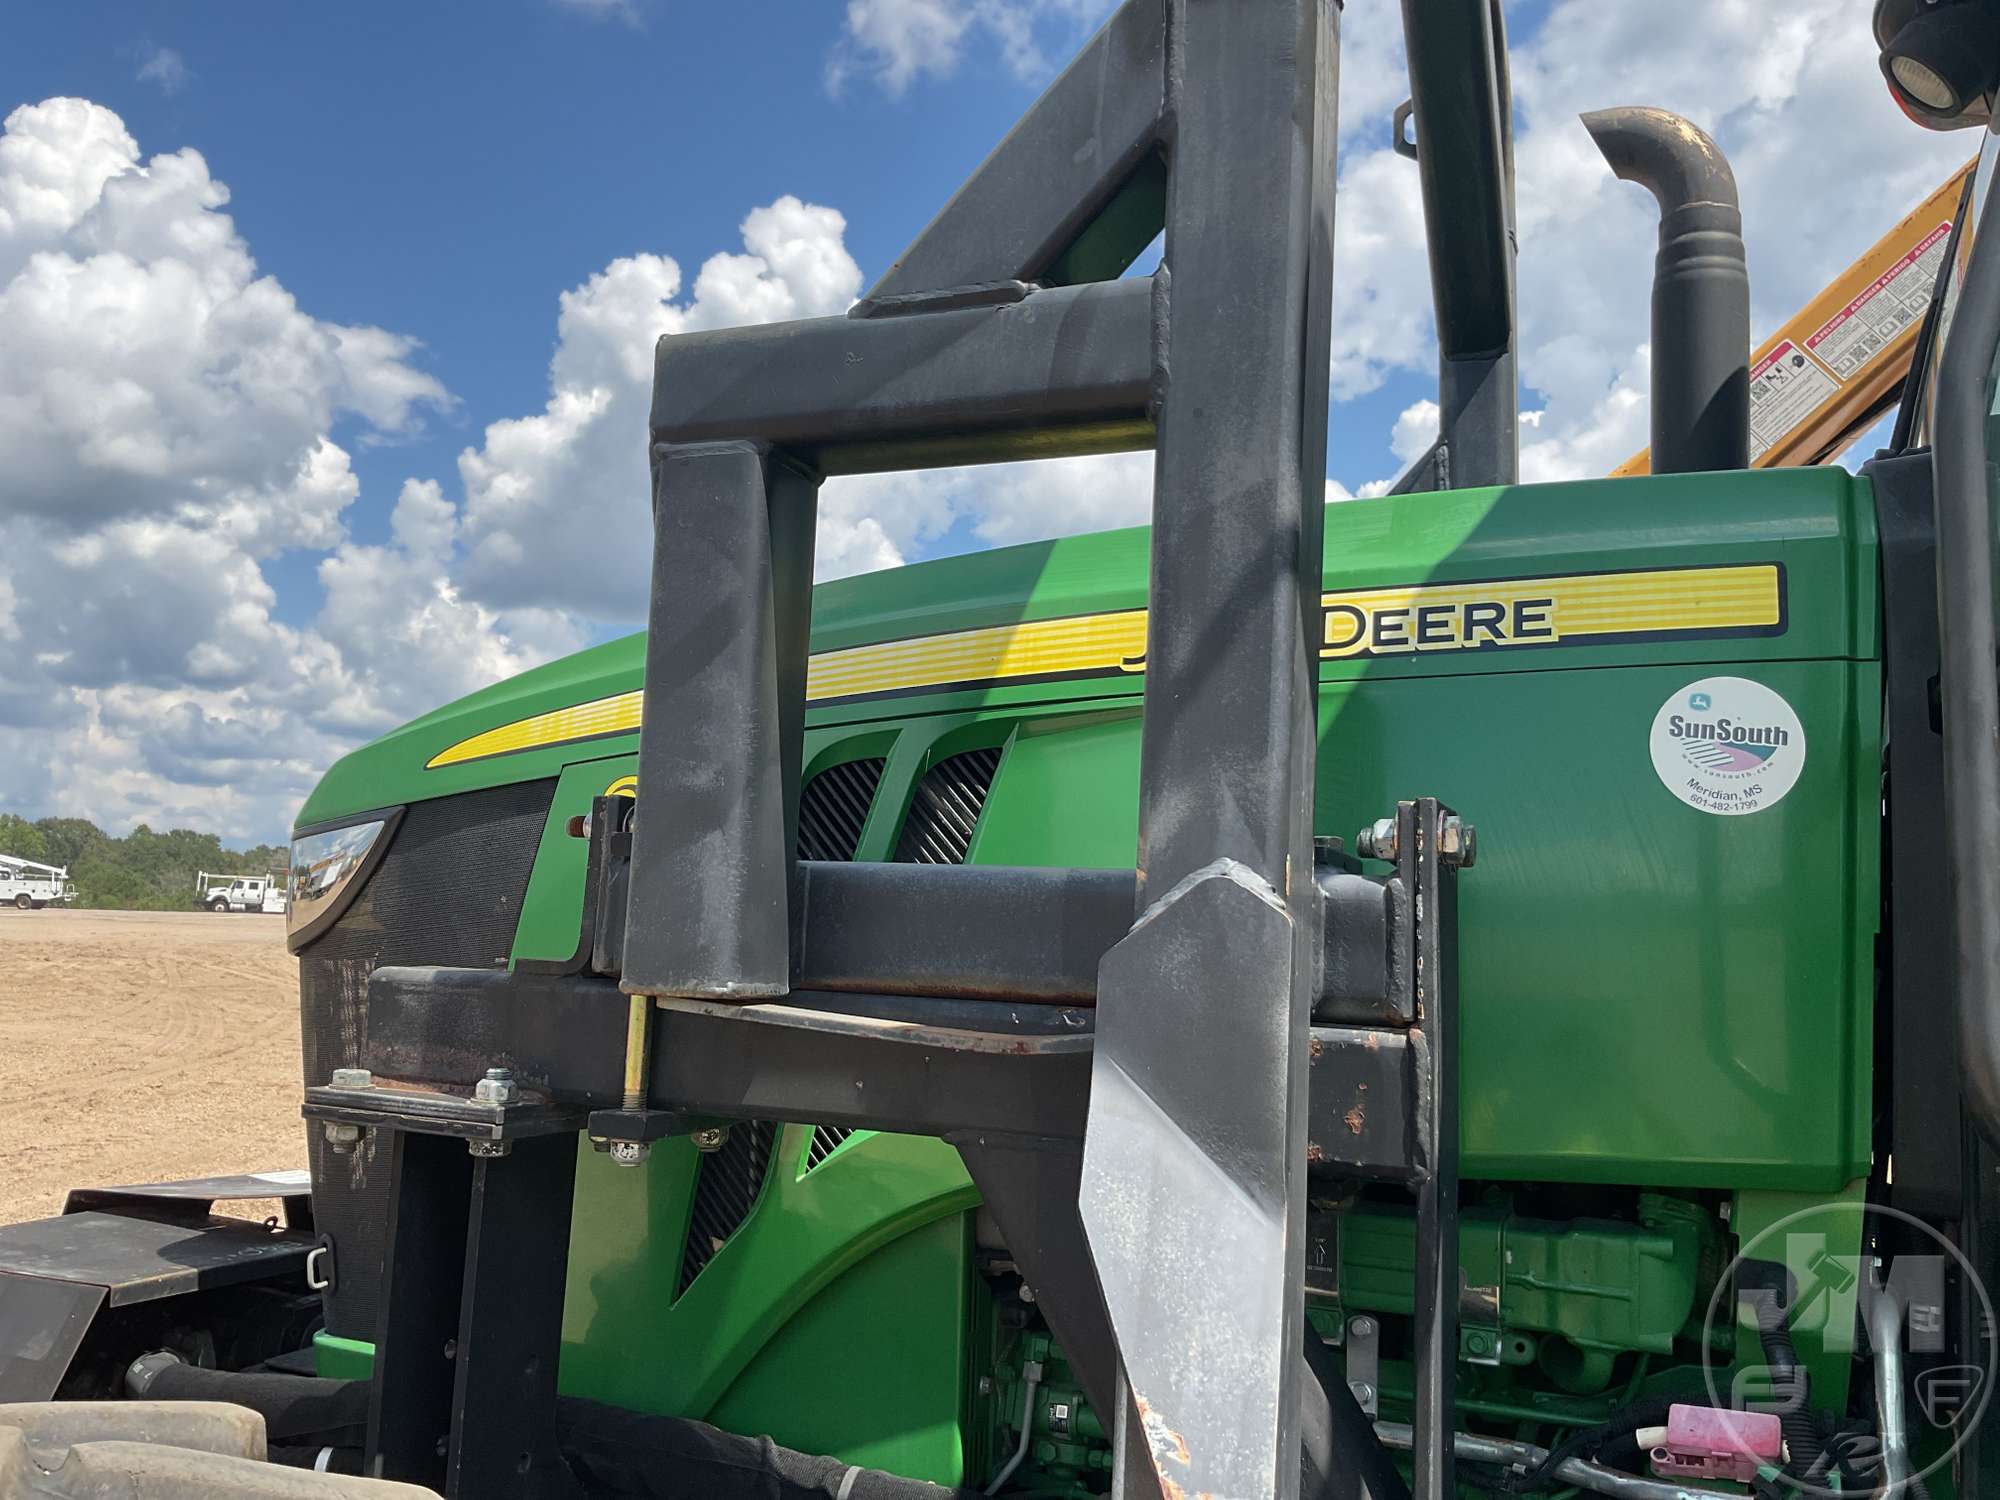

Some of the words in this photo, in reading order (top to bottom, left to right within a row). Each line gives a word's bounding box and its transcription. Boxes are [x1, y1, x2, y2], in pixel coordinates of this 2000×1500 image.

[1854, 283, 1882, 308] DANGER
[1322, 598, 1553, 651] DEERE
[1669, 715, 1788, 746] SunSouth
[1686, 779, 1742, 801] Meridian,
[1743, 784, 1763, 799] MS
[1690, 794, 1758, 811] 601-482-1799
